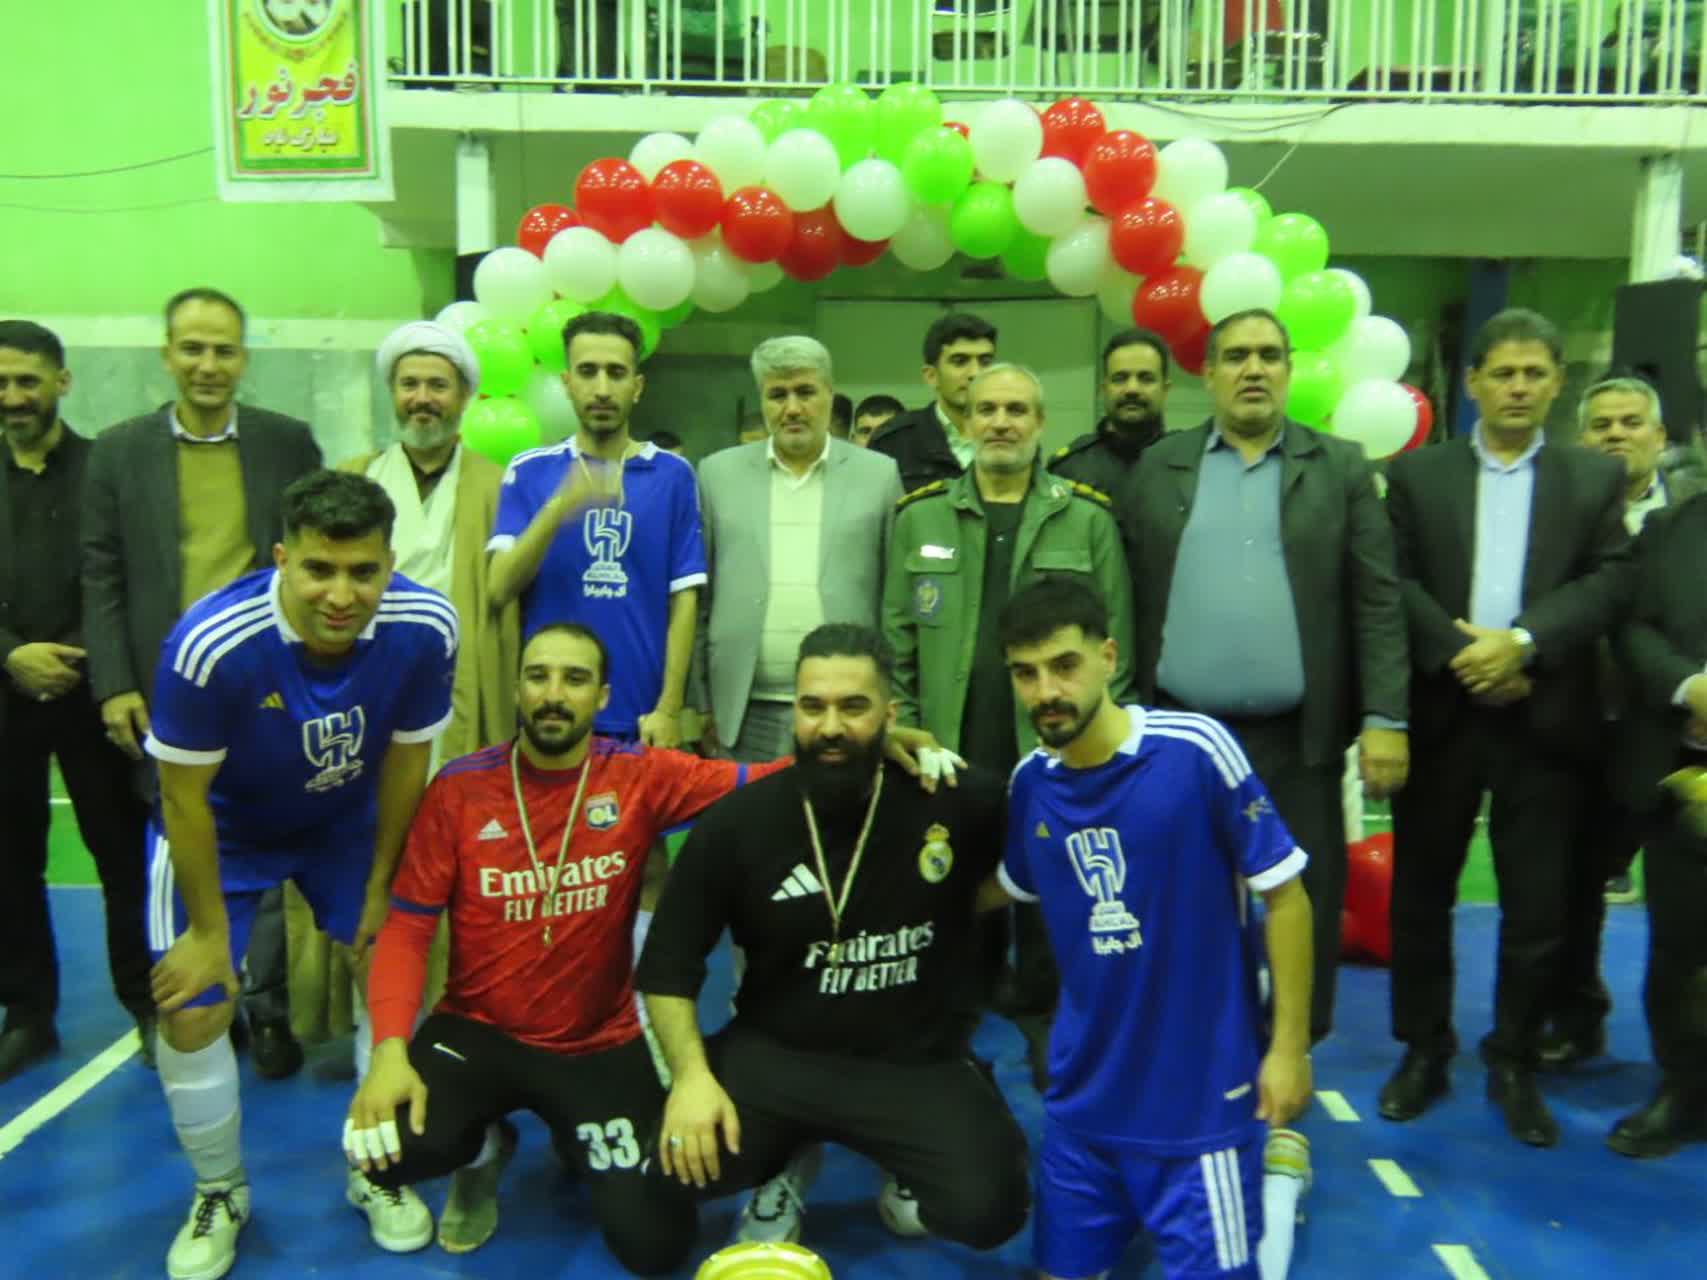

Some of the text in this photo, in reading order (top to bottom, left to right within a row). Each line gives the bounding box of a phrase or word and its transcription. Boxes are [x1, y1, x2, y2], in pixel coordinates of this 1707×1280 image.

[237, 61, 357, 121] فجر نور
[480, 851, 626, 897] Emirates
[504, 899, 537, 922] FLY
[819, 966, 853, 994] FLY
[576, 1118, 641, 1171] 33
